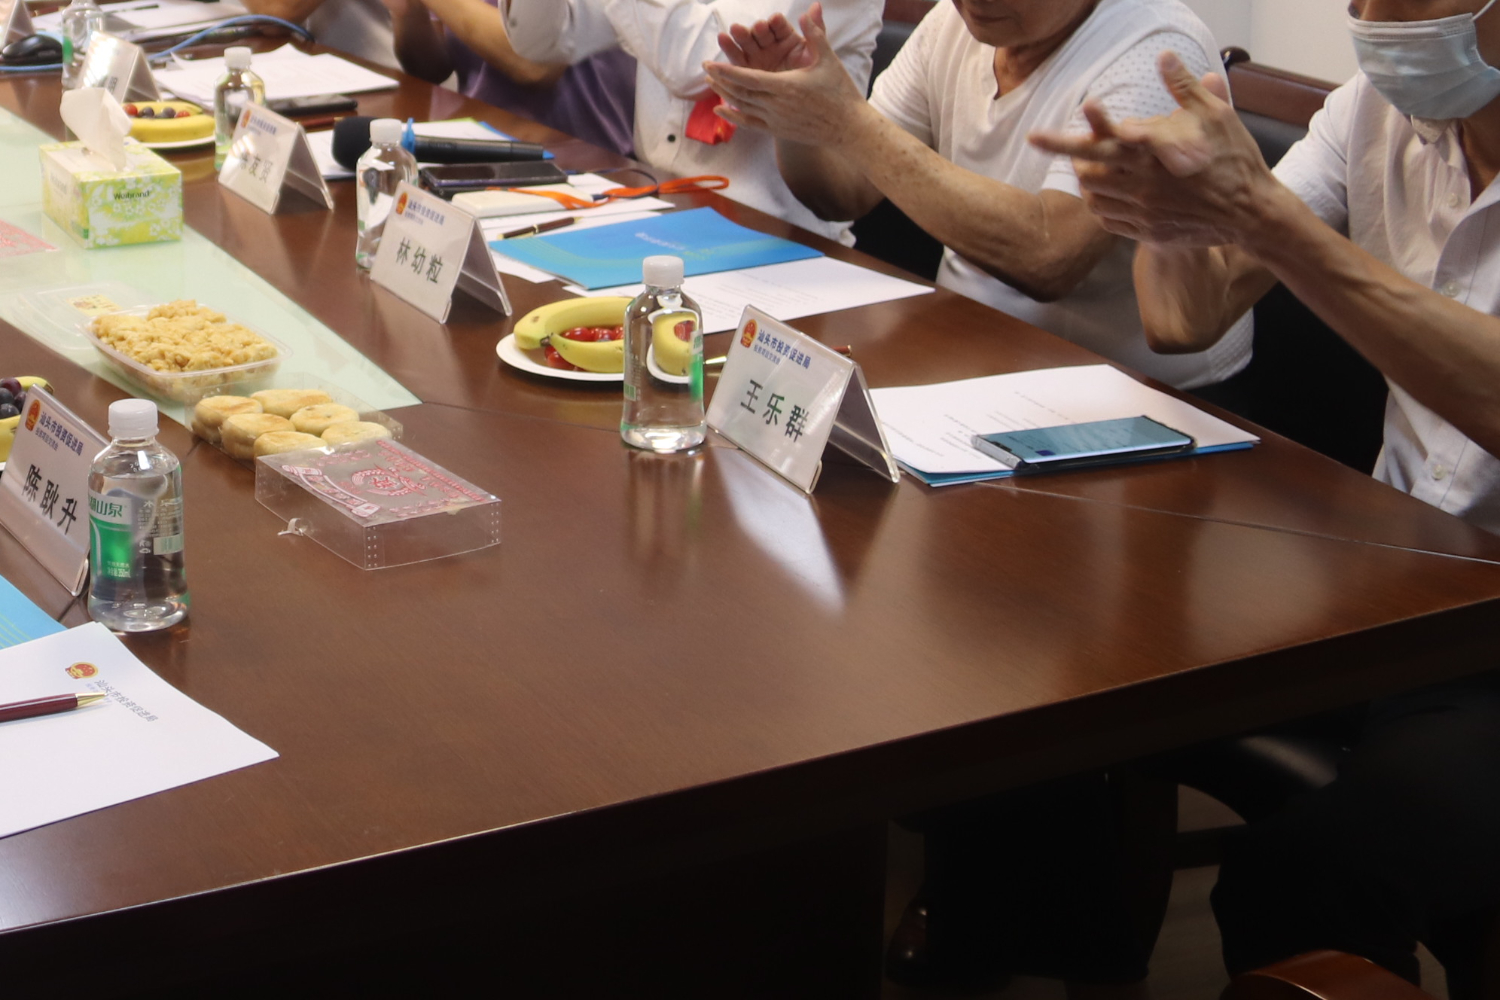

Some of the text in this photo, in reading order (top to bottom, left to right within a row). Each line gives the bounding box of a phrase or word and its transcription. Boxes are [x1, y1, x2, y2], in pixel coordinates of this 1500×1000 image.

[396, 237, 443, 284] 林幼粒
[757, 329, 812, 369] 汕头市投资促进局
[39, 411, 84, 457] 汕头市投资促进局
[740, 379, 810, 443] 王乐群
[21, 464, 78, 536] 陈耿升
